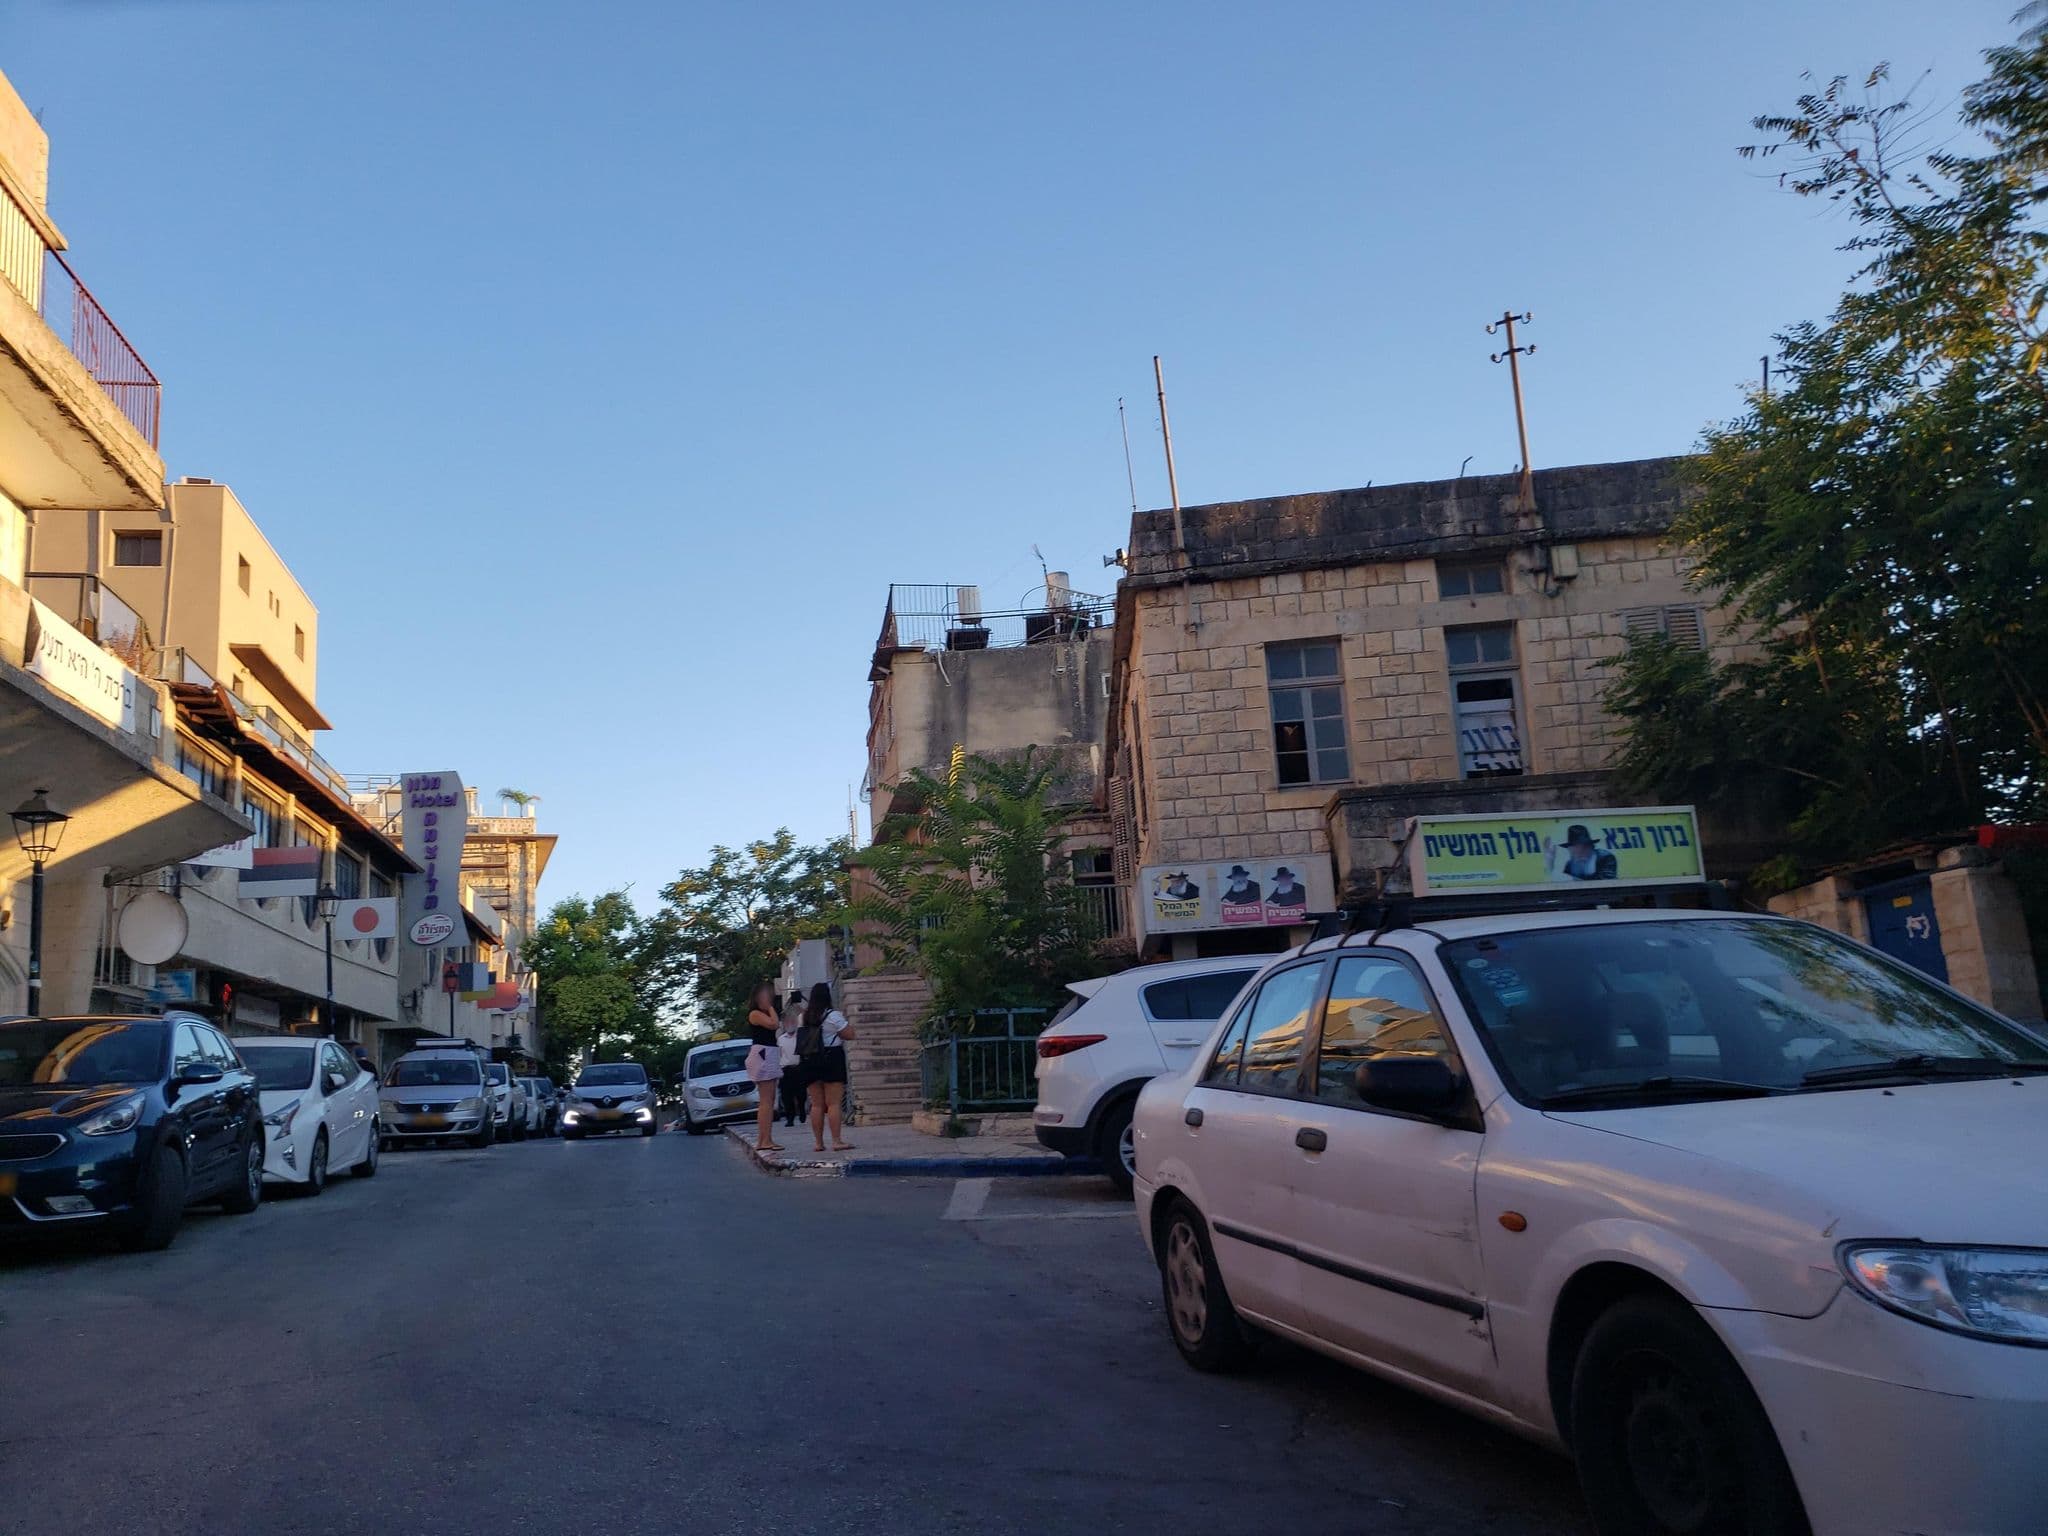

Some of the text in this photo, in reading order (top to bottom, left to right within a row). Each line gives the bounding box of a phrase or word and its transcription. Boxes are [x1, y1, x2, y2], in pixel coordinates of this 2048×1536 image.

[411, 791, 458, 808] Hotel
[1424, 824, 1690, 859] ברוך הבא מלך המשיח
[1157, 902, 1183, 912] המלך
[1223, 905, 1261, 915] המשיח
[1268, 907, 1305, 917] המשיח
